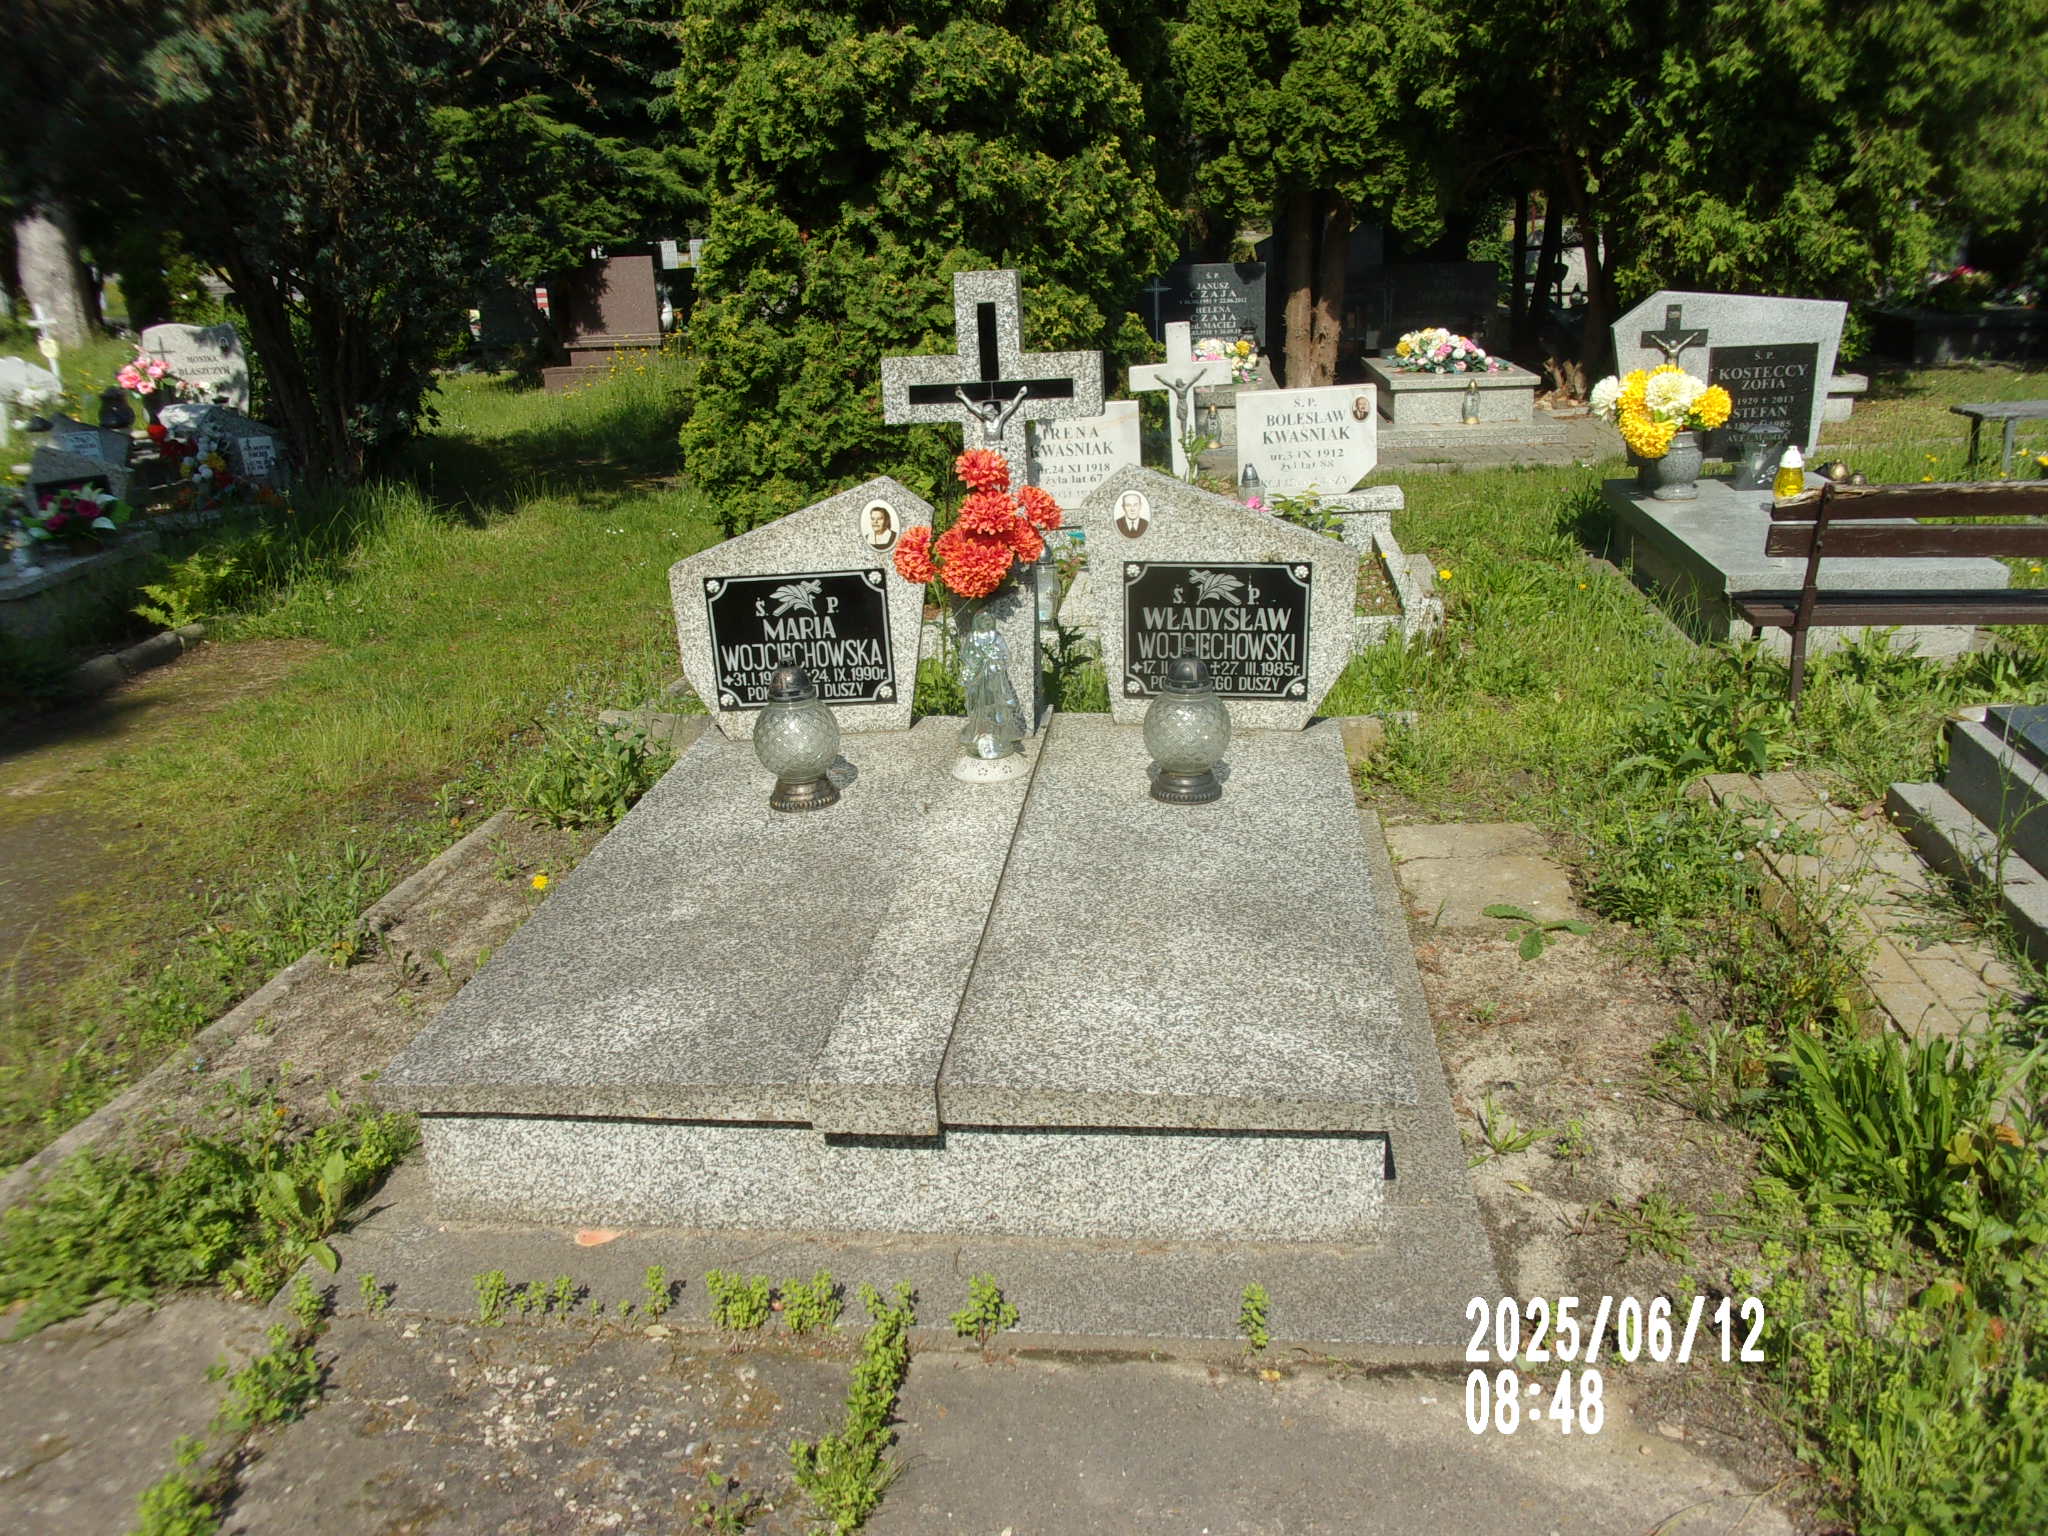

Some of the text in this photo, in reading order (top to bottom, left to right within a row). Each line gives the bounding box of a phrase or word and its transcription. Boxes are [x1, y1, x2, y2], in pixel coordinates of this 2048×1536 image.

[1197, 282, 1230, 290] JANUSZ
[1190, 289, 1237, 298] CZAJA
[1190, 313, 1237, 322] CZAJA
[1720, 364, 1809, 380] KOSTECCY
[1741, 378, 1786, 390] ZOFIA
[1733, 406, 1788, 418] STEFAN
[1042, 426, 1099, 440] IRENA
[1086, 463, 1110, 472] 1918
[826, 597, 839, 613] P.
[1143, 607, 1292, 631] WŁADYSŁAW
[763, 616, 836, 641] MARIA
[1137, 631, 1296, 662] WOJCIECHOWSKI
[721, 638, 883, 671] WOJCIECHOWSKA
[825, 682, 864, 698] DUSZY
[1238, 677, 1280, 691] DUSZY
